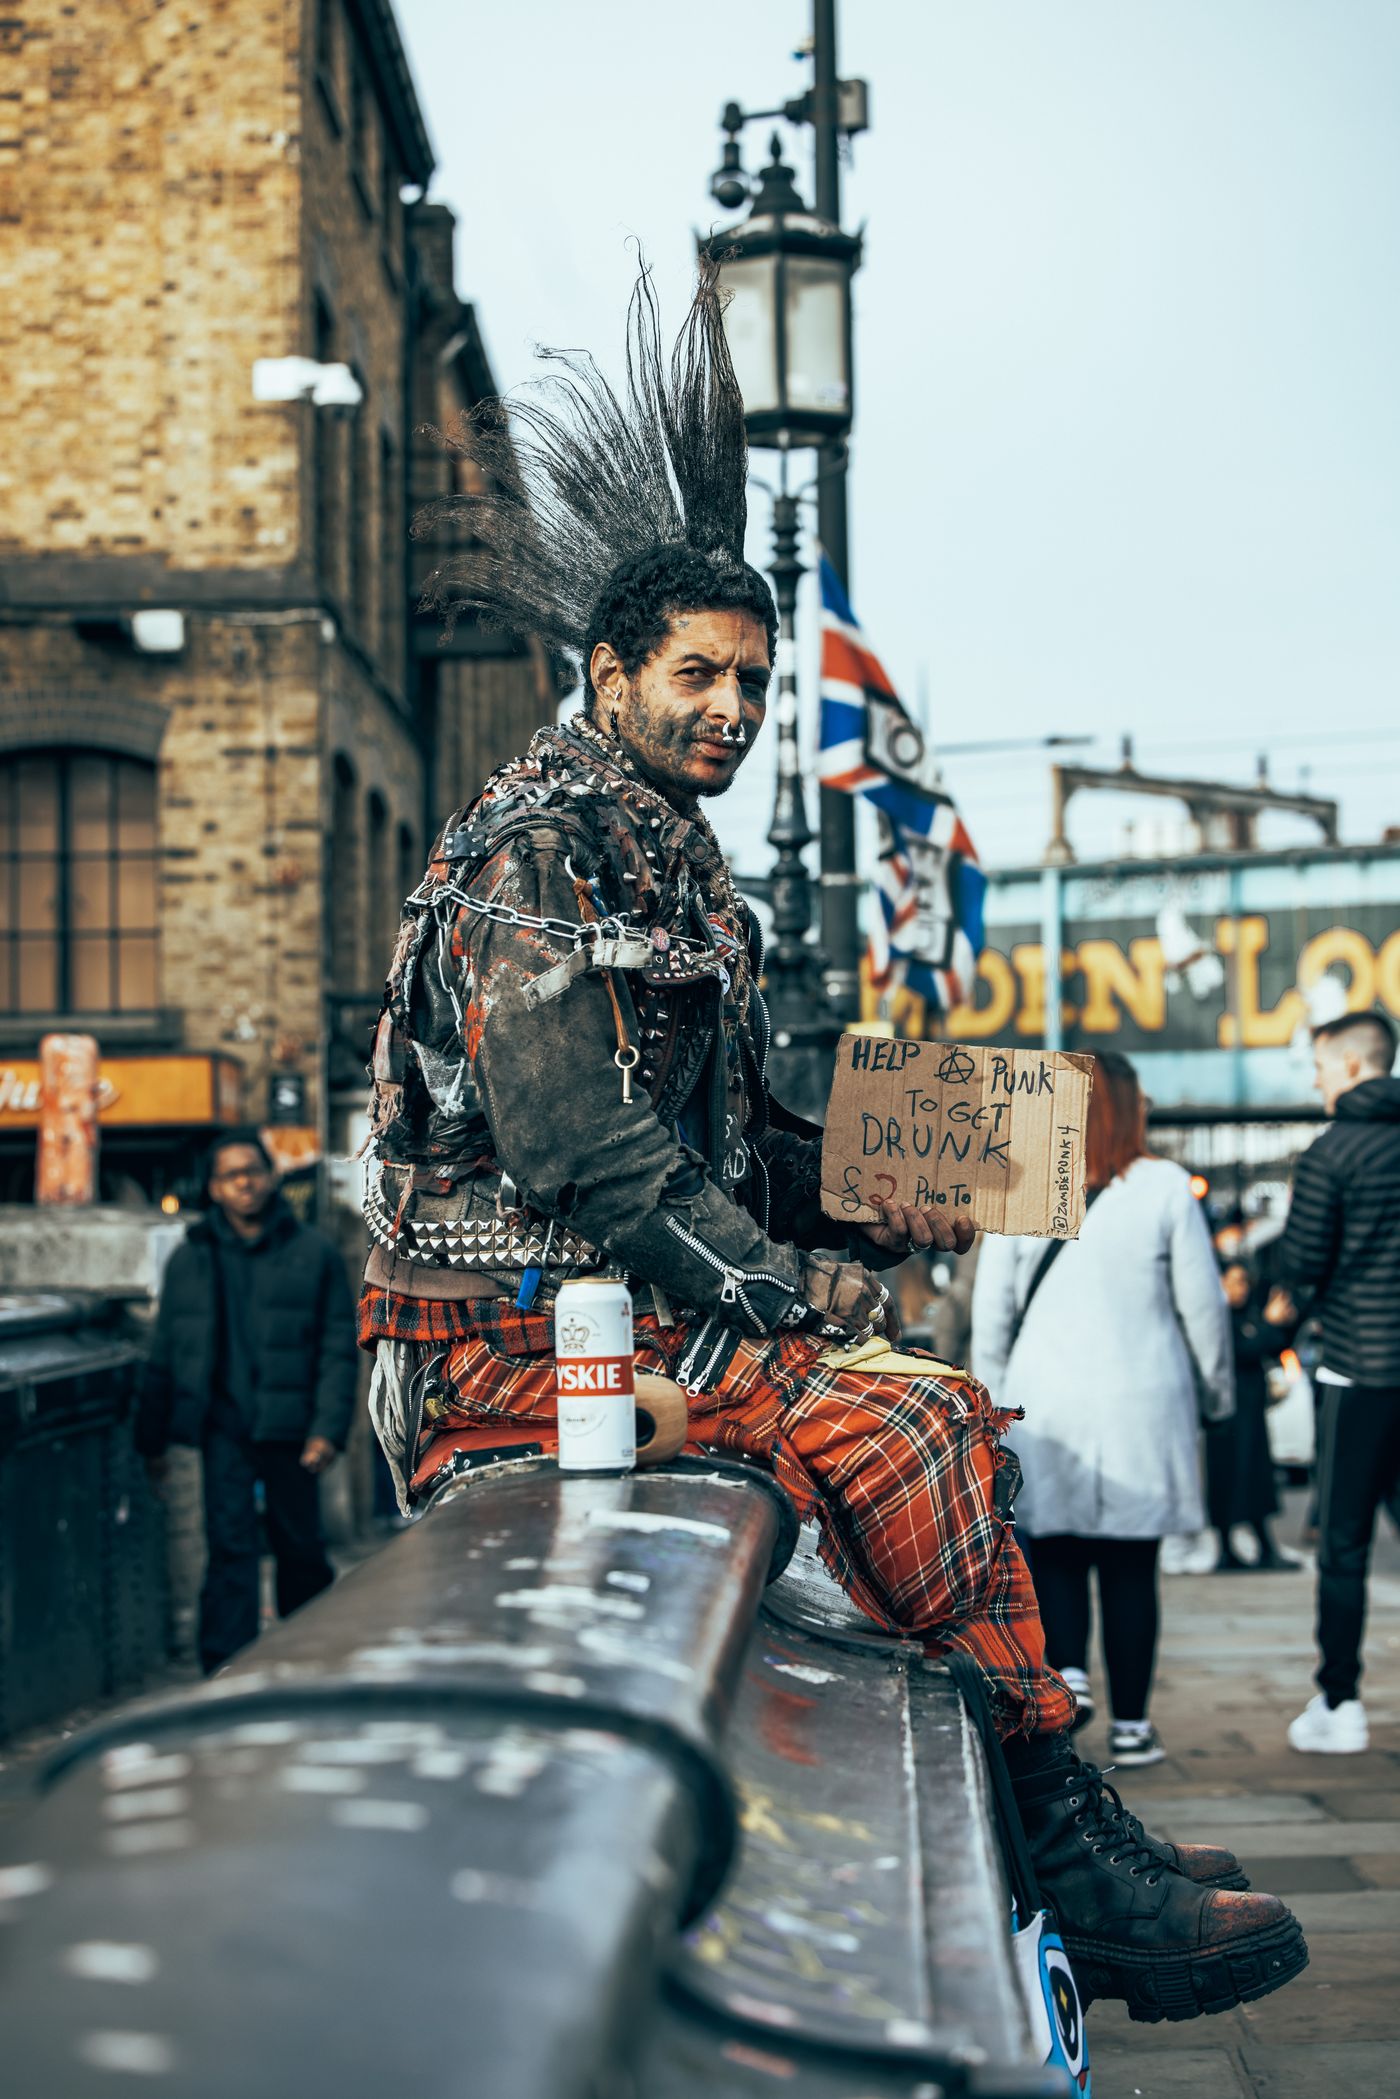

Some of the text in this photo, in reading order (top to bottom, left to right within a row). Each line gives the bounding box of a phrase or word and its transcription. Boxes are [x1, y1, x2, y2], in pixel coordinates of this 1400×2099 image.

[851, 1038, 921, 1072] HELP
[991, 1056, 1054, 1096] PUNK
[862, 1113, 1011, 1168] DRUNK
[948, 1102, 1010, 1132] GET
